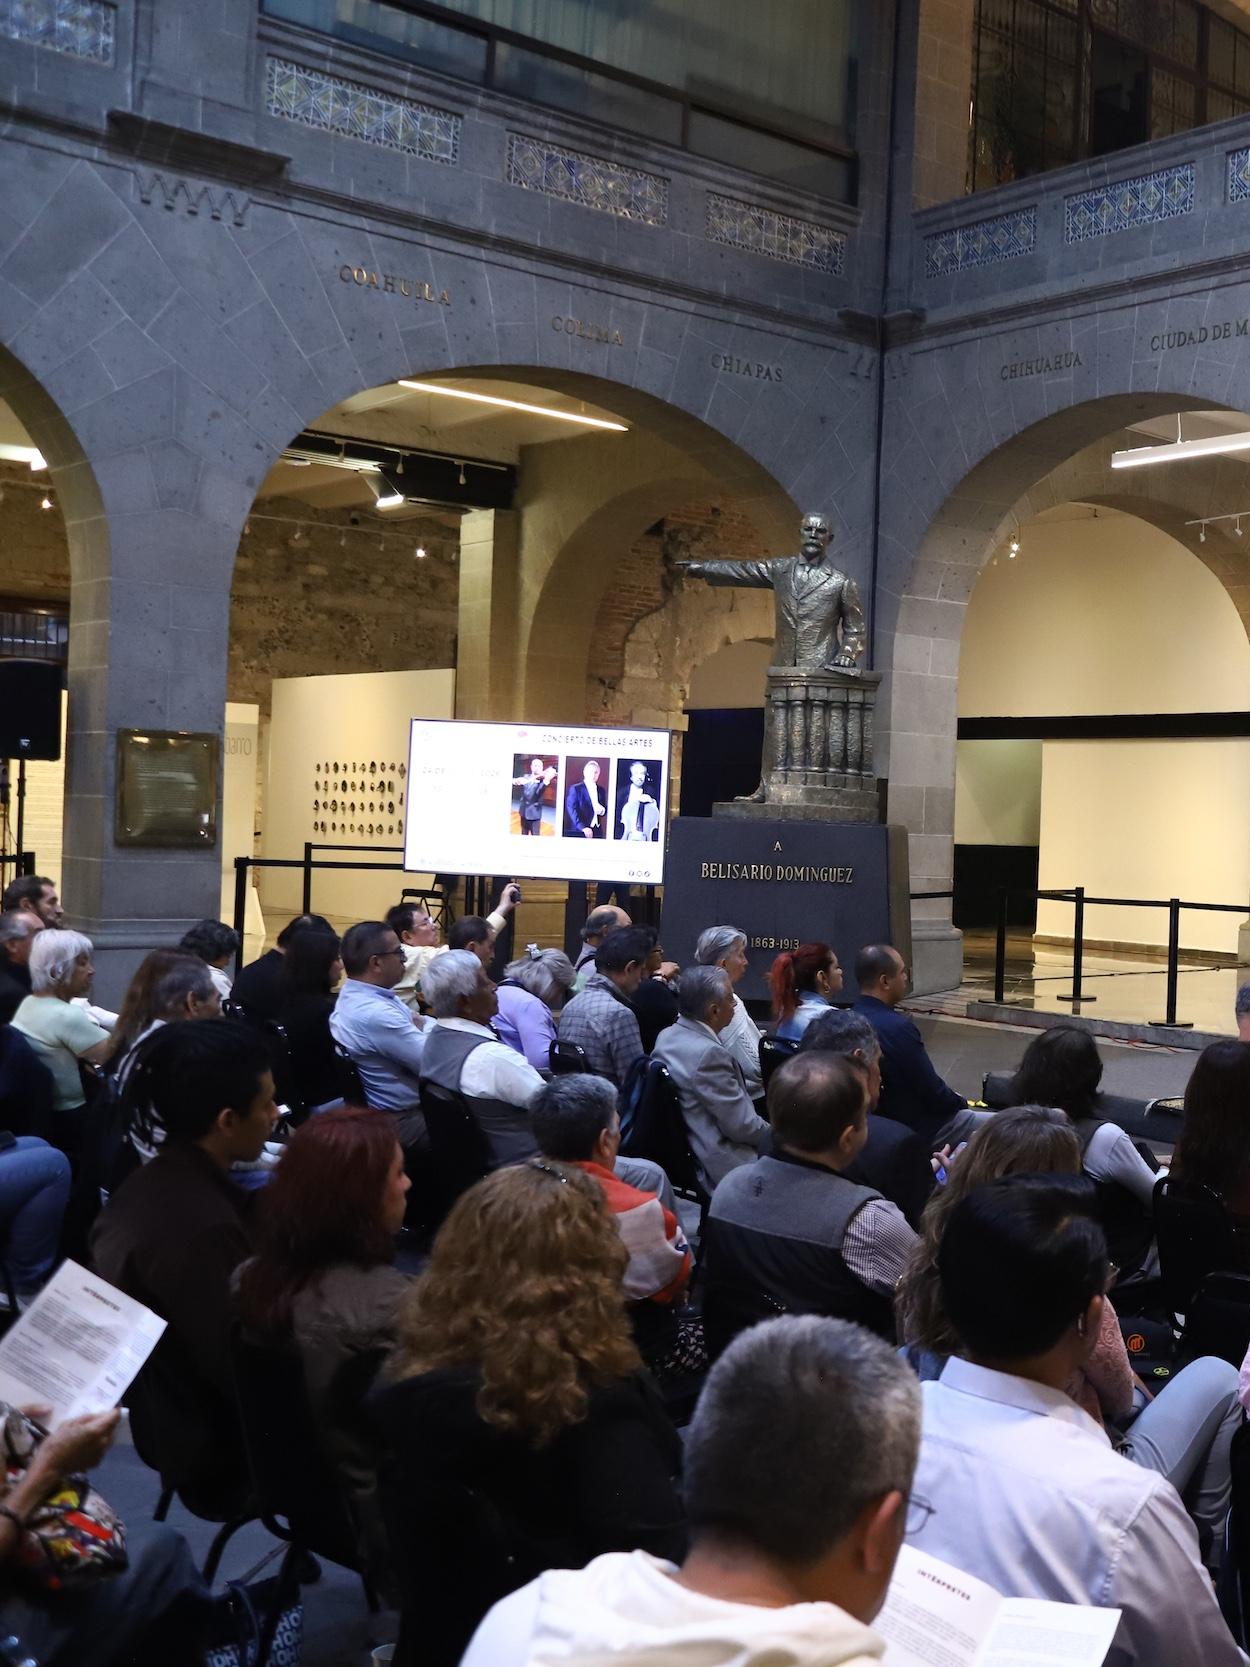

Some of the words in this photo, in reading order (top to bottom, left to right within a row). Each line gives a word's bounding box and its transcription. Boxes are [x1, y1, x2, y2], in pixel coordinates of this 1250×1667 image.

[339, 263, 451, 306] COAHUILA
[551, 315, 624, 347] COLIMA
[1150, 326, 1208, 351] CIUDAD
[1212, 322, 1231, 341] DE
[711, 353, 784, 383] CHIAPAS
[1000, 352, 1083, 381] CHIHUAHUA
[598, 737, 627, 747] BELLAS
[628, 738, 653, 748] ARTES
[774, 841, 782, 851] A
[701, 862, 772, 881] BELISARIO
[776, 865, 853, 884] DOMINGUEZ
[751, 937, 800, 950] 1863-1913
